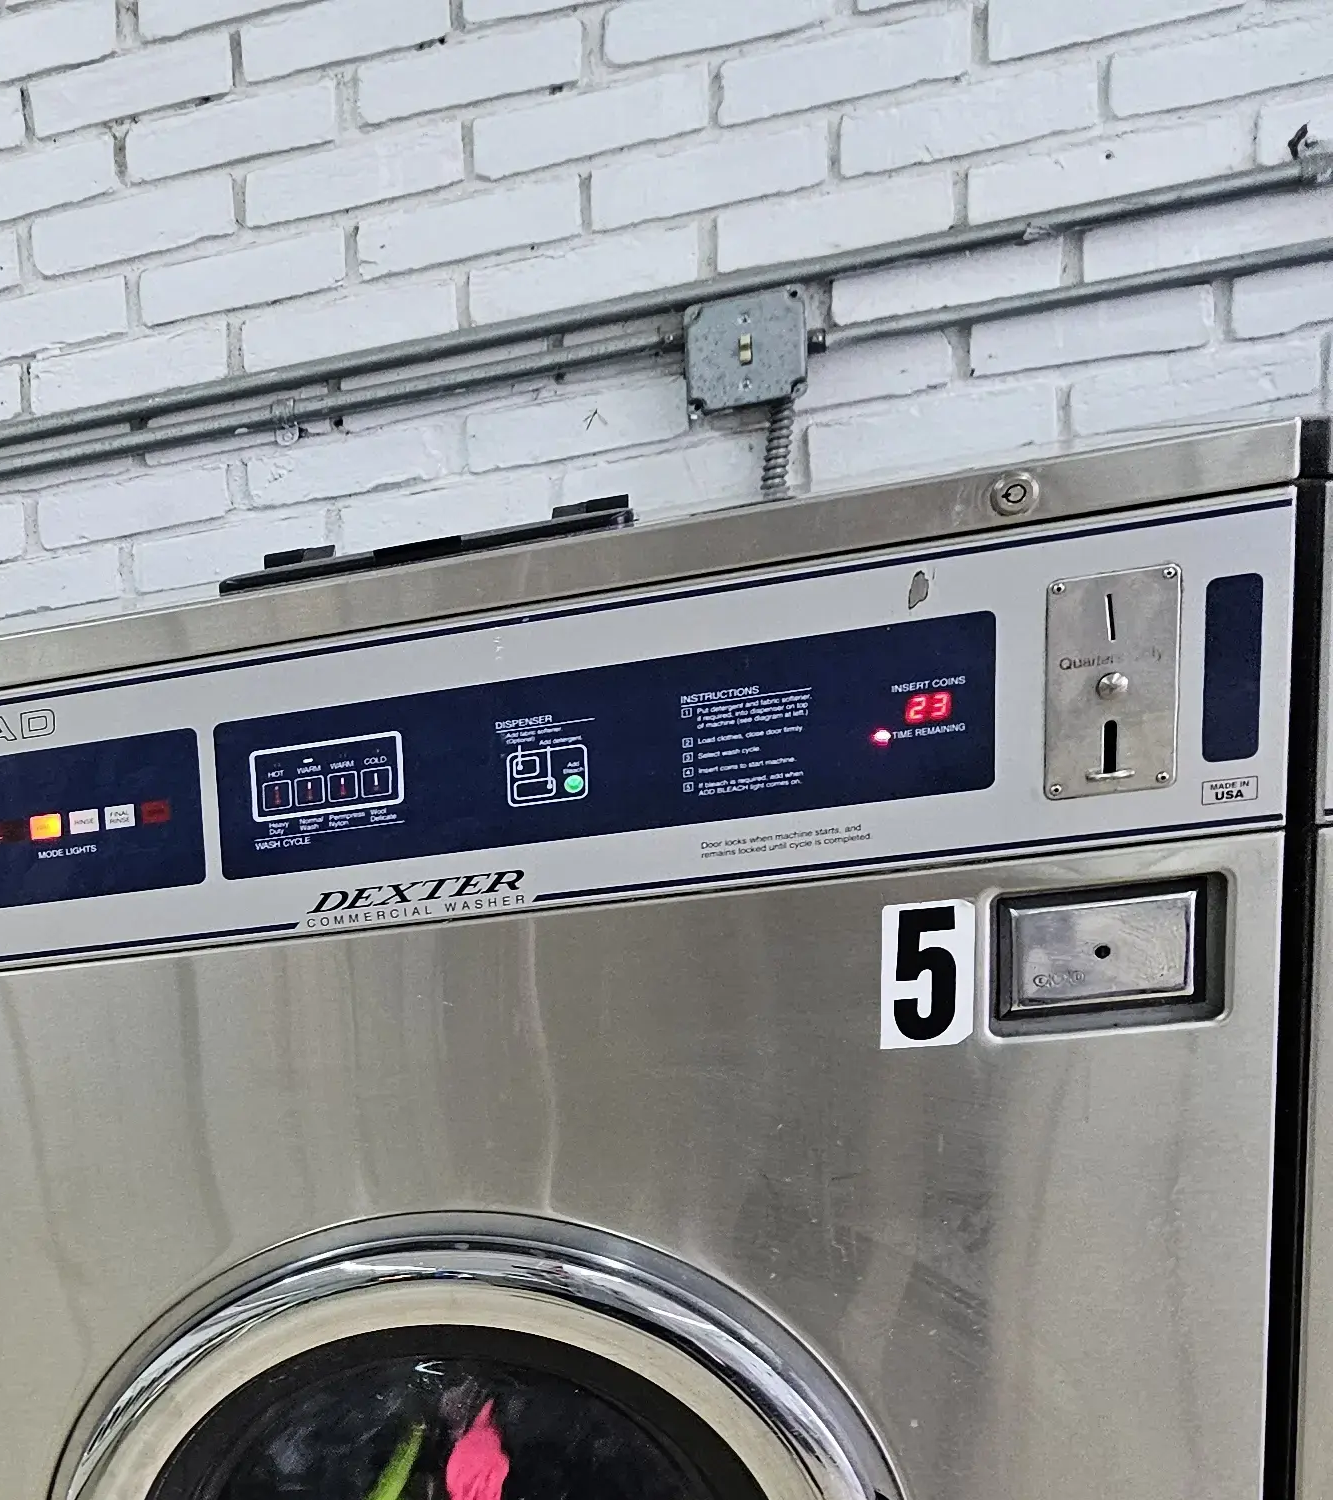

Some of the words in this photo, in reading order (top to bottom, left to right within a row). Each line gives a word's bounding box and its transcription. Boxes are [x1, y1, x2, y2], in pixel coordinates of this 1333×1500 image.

[891, 681, 930, 692] INSERT
[932, 676, 966, 687] COINS
[681, 685, 759, 704] INSTRUCTIONS
[711, 703, 743, 712] detergent
[750, 705, 784, 714] dispenser
[909, 691, 951, 720] 23
[495, 715, 552, 729] DISPENSER
[892, 730, 913, 739] TIME
[915, 723, 965, 736] REMAINING
[698, 737, 715, 745] Load
[698, 751, 720, 759] Select
[268, 770, 284, 778] HOT
[297, 765, 321, 775] WARM
[330, 760, 354, 769] WARM
[364, 756, 387, 765] COLD
[705, 780, 728, 788] bleach
[717, 785, 748, 793] BLEACH
[1210, 782, 1236, 790] MADE
[1239, 780, 1250, 788] IN
[1215, 790, 1244, 800] USA
[299, 816, 324, 825] Normal
[329, 820, 349, 828] Nylon
[370, 813, 397, 823] Delicate
[255, 840, 280, 850] WASH
[283, 837, 311, 846] CYCLE
[701, 841, 722, 850] Door
[725, 838, 747, 846] locks
[750, 835, 772, 843] when
[775, 831, 813, 841] machine
[815, 827, 841, 836] starts,
[845, 824, 862, 832] and
[38, 849, 63, 859] MODE
[65, 845, 97, 856] LIGHTS
[701, 848, 735, 859] remains
[739, 845, 766, 854] locked
[768, 842, 787, 851] until
[789, 840, 811, 850] cycle
[815, 838, 821, 846] is
[824, 832, 872, 844] completed.
[307, 869, 525, 914] DEXTER
[307, 905, 432, 928] COMMERCIAL
[444, 894, 525, 912] WASHER
[893, 906, 956, 1041] 5
